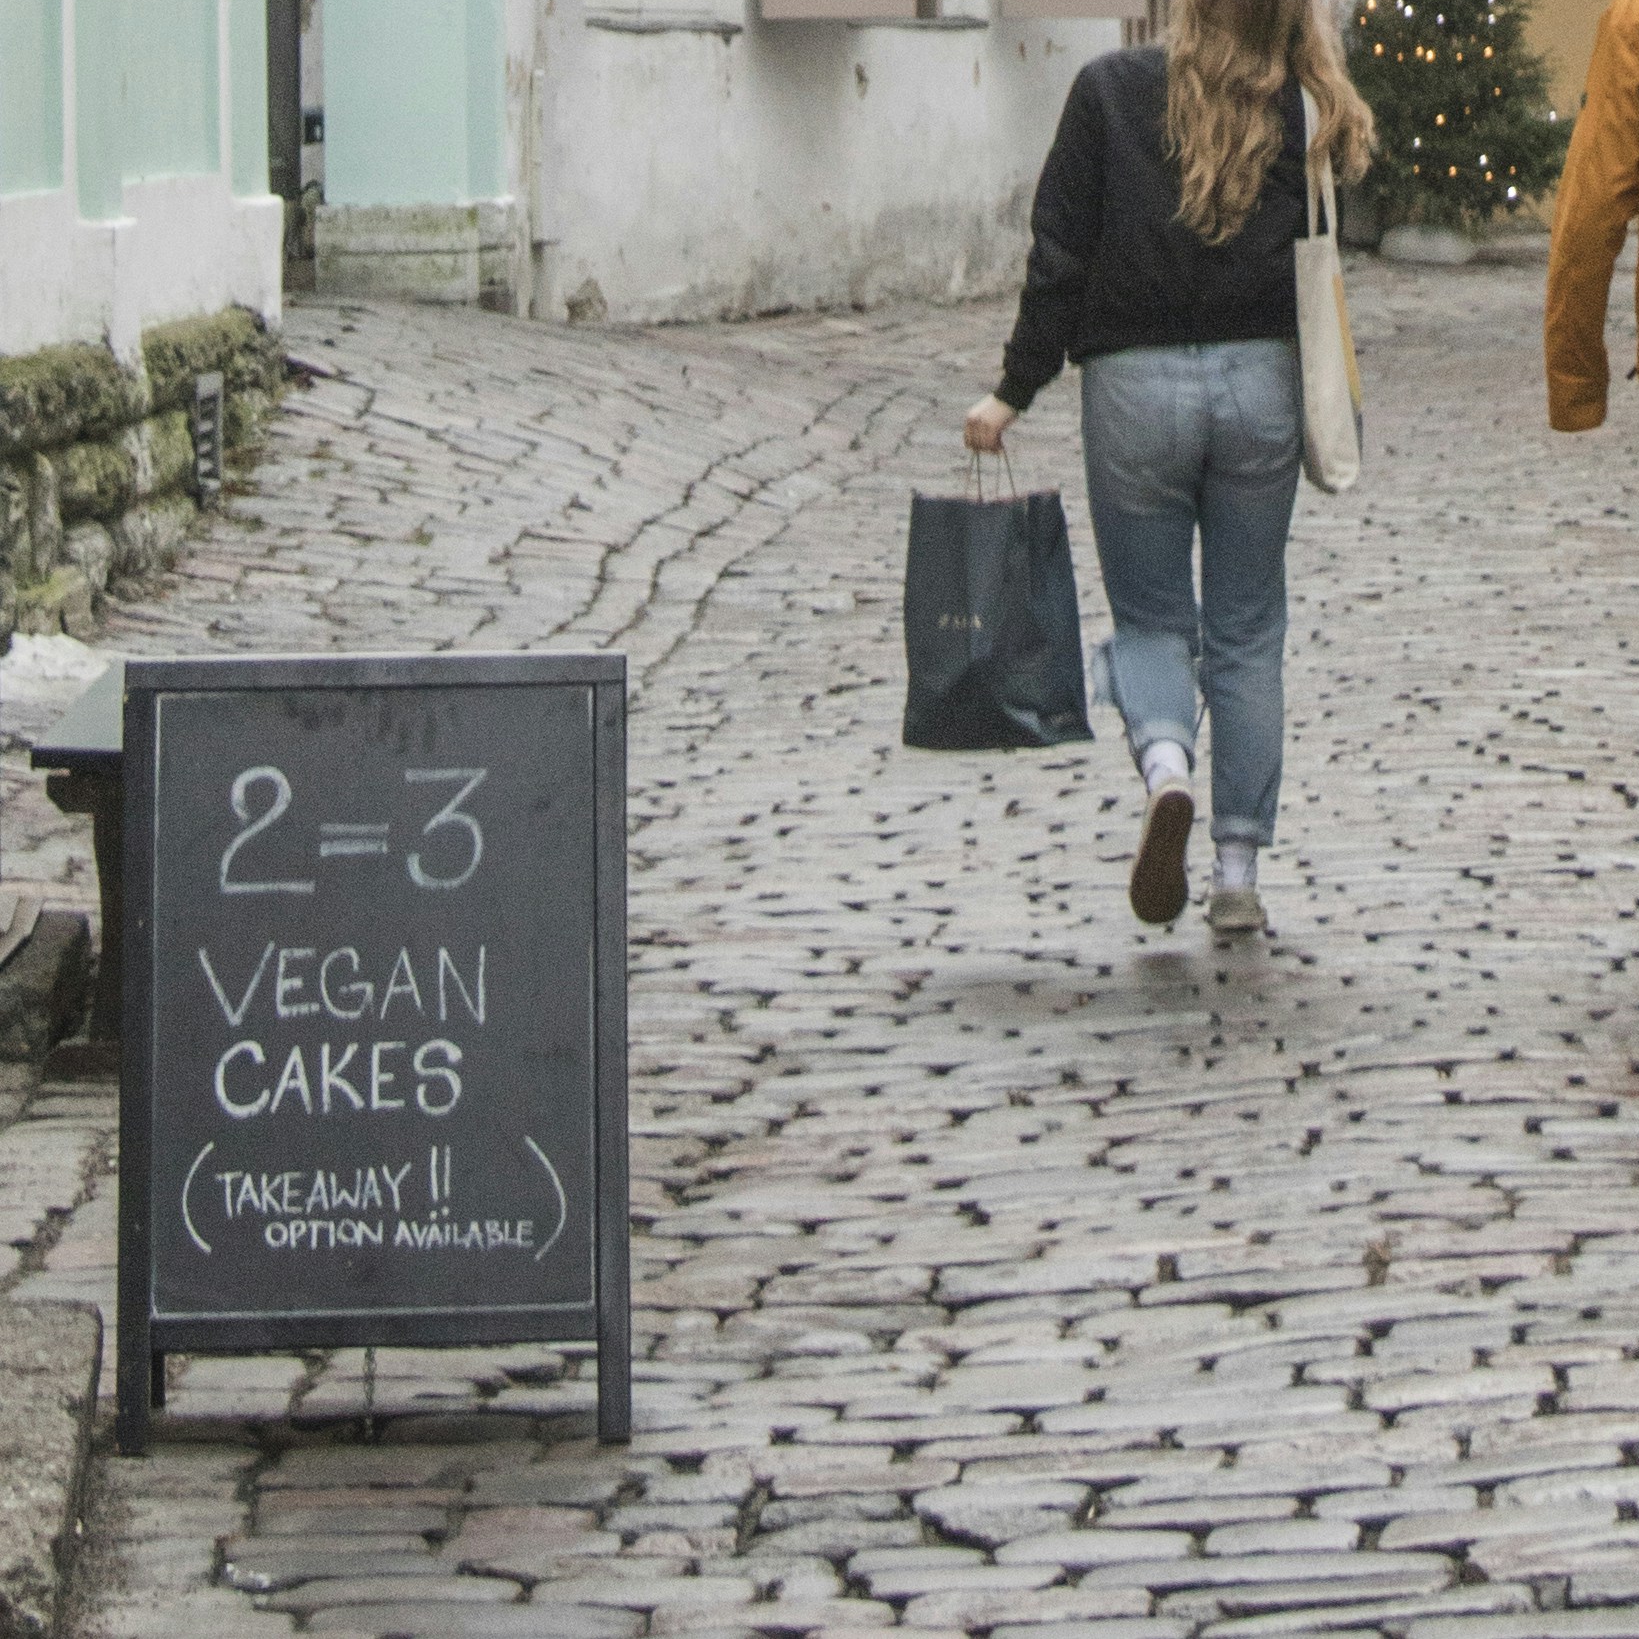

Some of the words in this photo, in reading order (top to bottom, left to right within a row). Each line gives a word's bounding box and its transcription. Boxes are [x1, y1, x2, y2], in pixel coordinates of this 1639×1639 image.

[198, 941, 487, 1028] VEGAN
[213, 1038, 464, 1120] CAKES
[264, 1219, 384, 1251] OPTION
